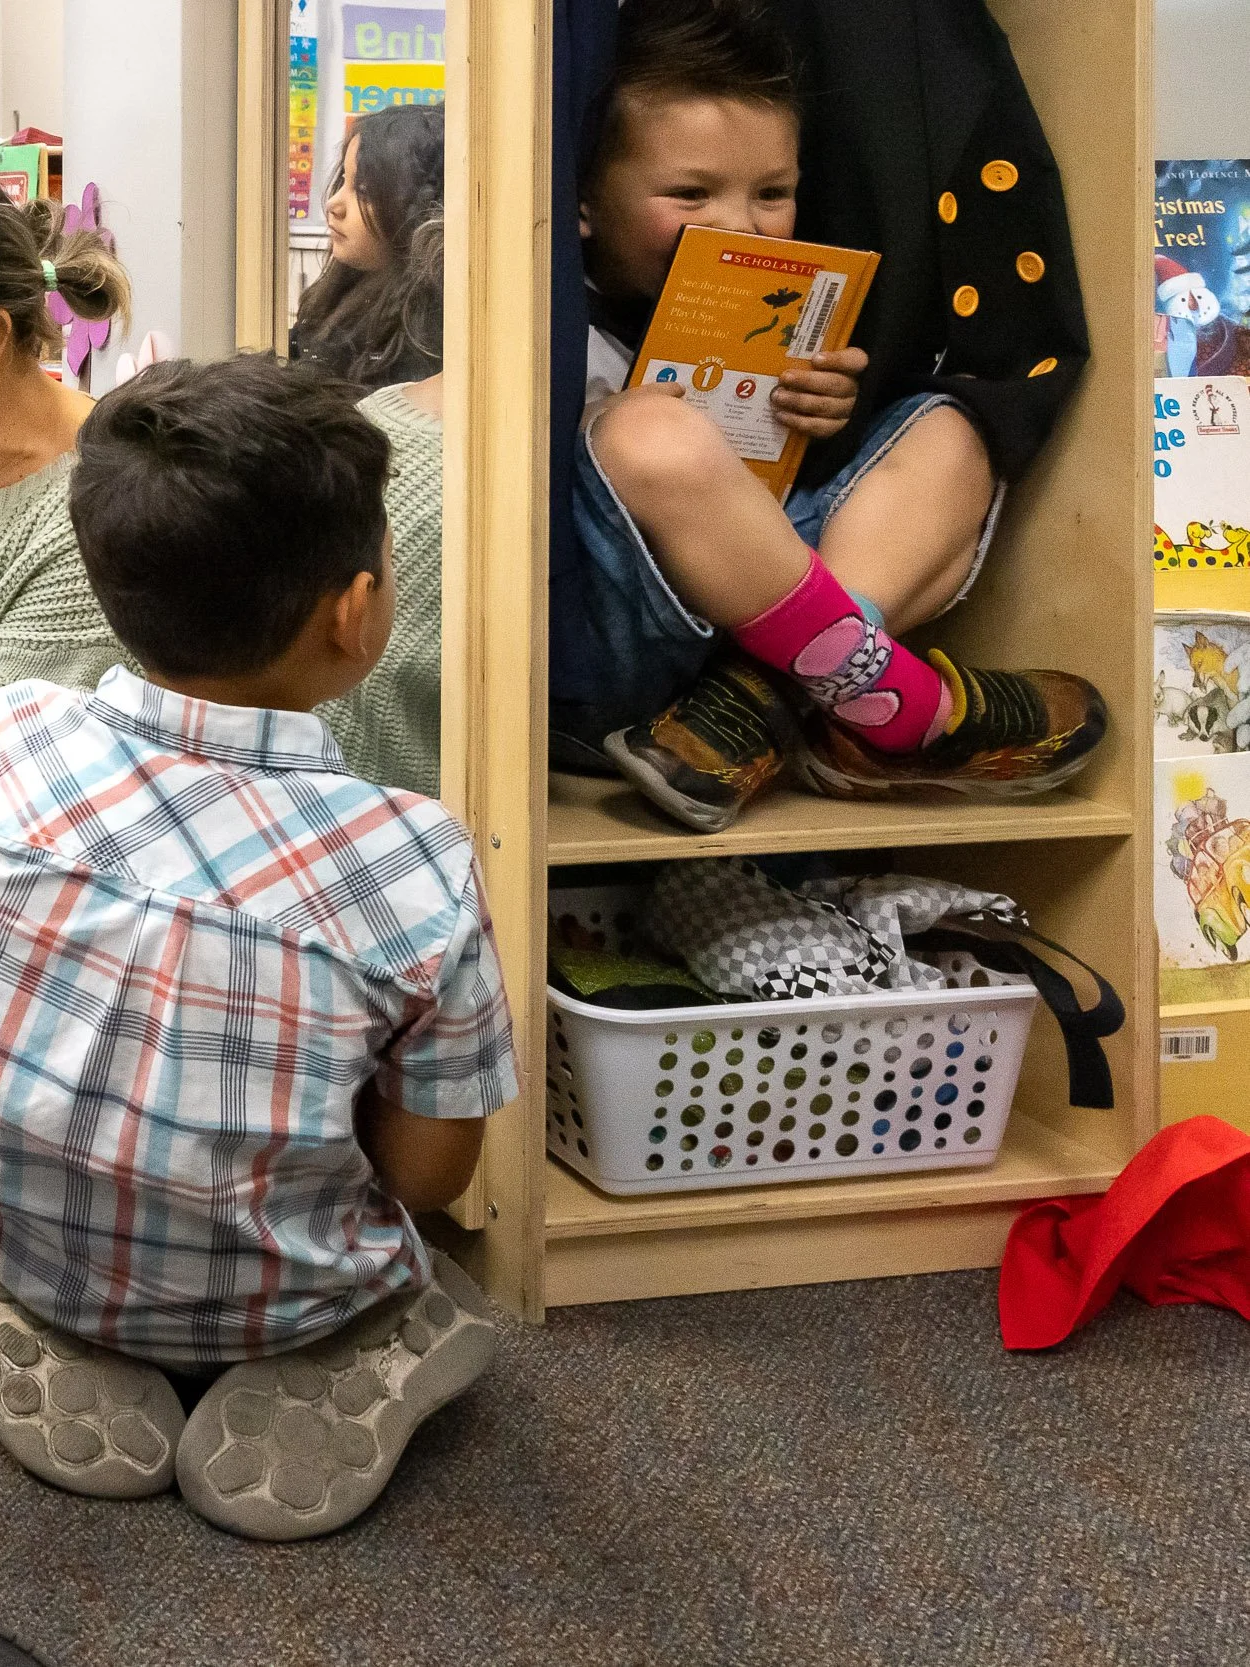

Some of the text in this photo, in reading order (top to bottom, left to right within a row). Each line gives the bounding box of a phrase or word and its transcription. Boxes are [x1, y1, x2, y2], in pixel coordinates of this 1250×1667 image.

[734, 254, 822, 275] SCHOLASTIC
[681, 278, 754, 297] See the picture.
[675, 292, 701, 304] Read
[702, 296, 718, 306] the
[670, 307, 689, 317] Play
[712, 329, 730, 340] do!
[699, 355, 727, 368] LEVEL
[701, 366, 714, 388] 1
[739, 382, 752, 396] 2
